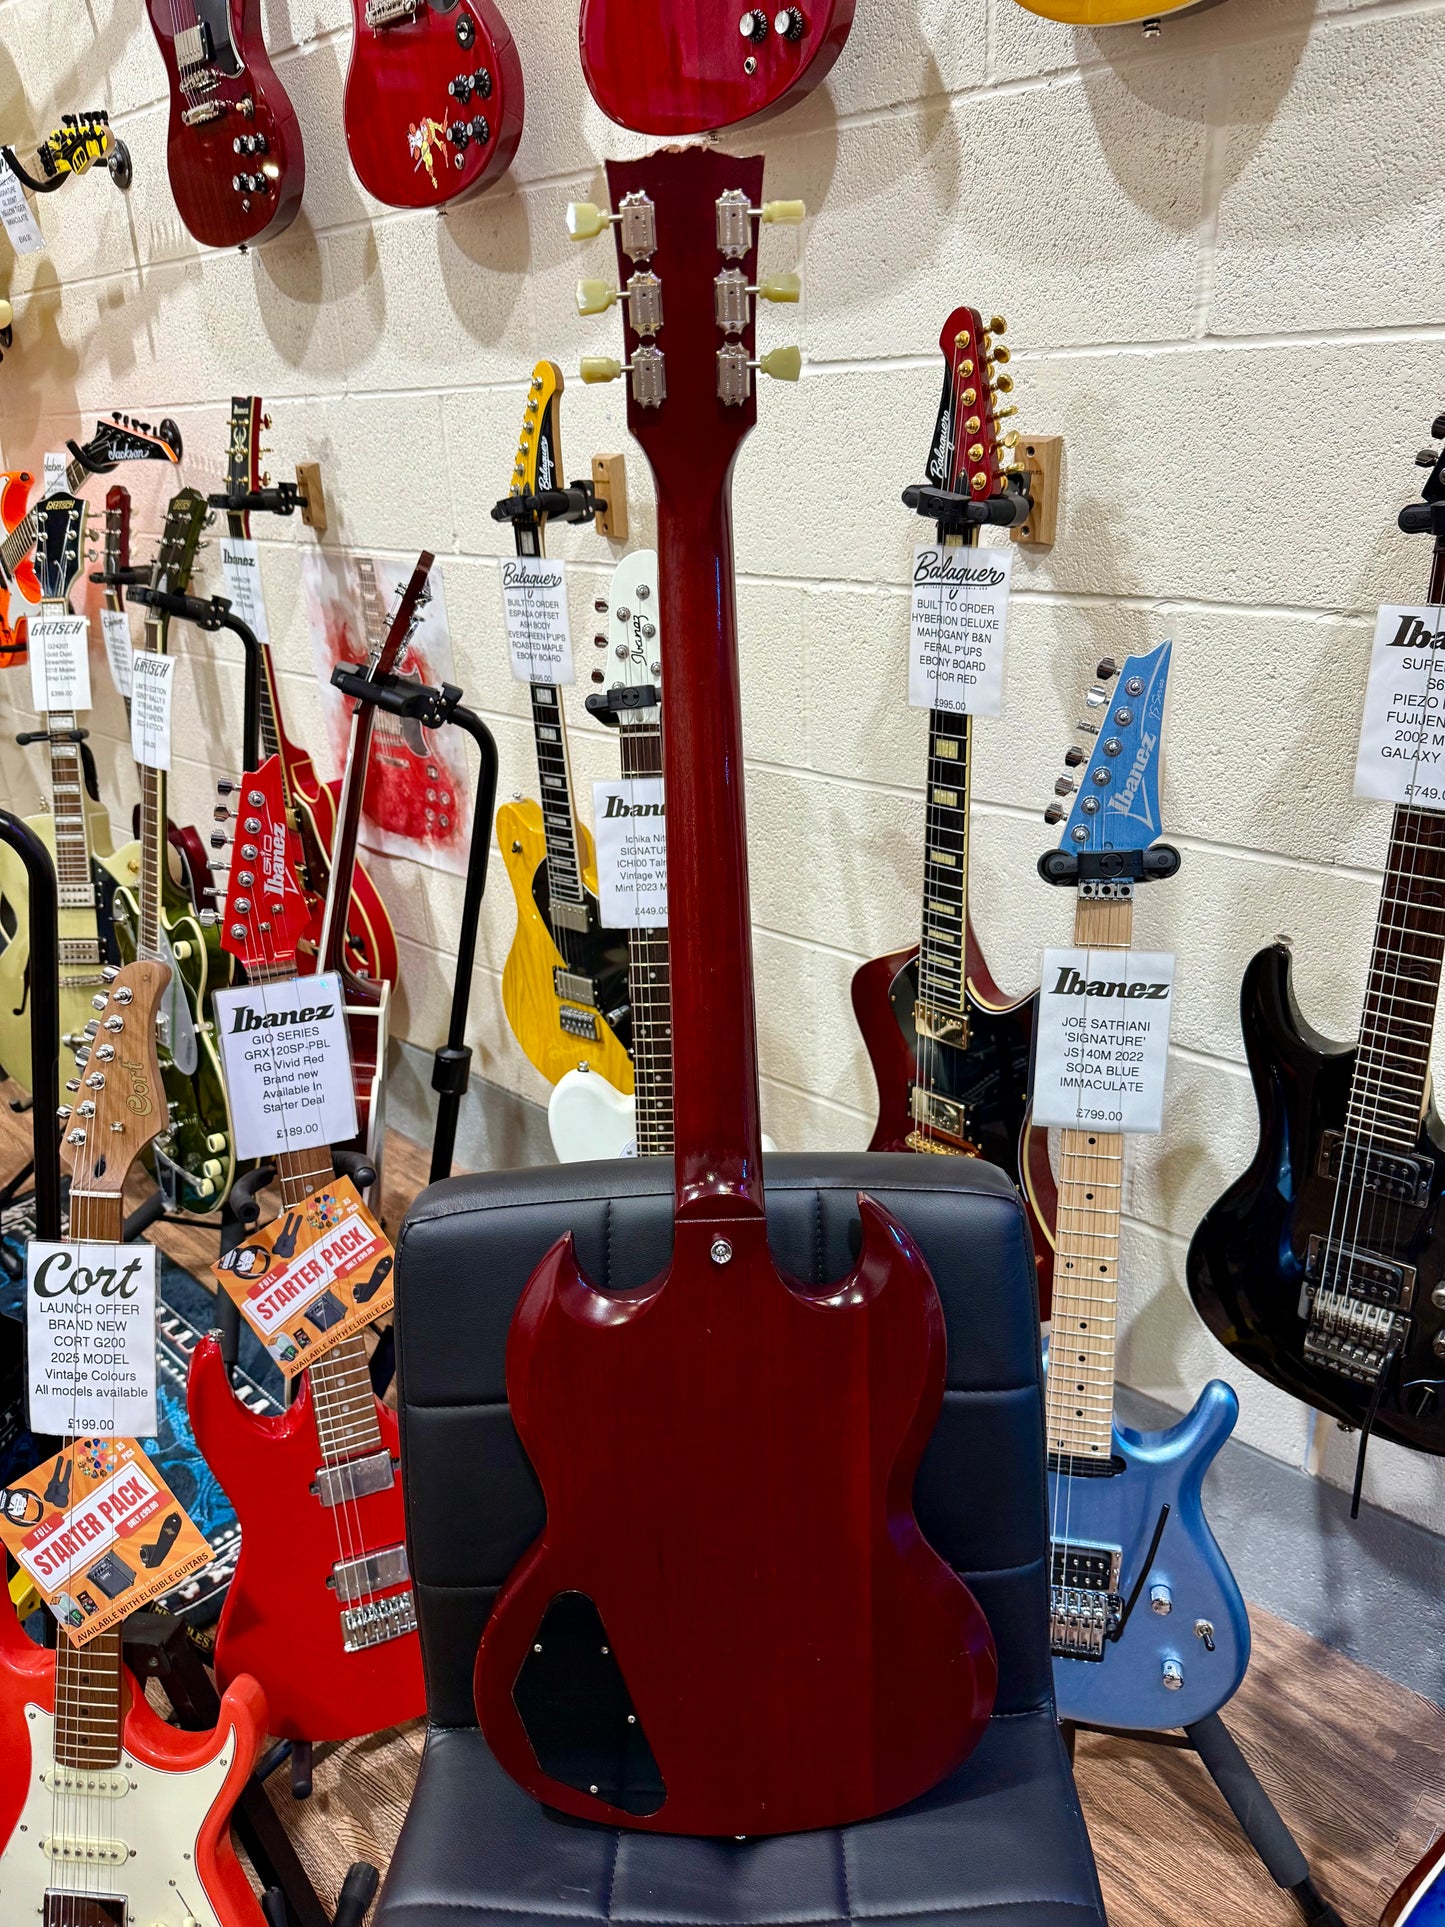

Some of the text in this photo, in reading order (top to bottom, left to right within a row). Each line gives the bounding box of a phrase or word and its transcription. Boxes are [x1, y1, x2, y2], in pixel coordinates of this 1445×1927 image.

[73, 149, 87, 171] LTD
[108, 441, 149, 460] Jackson
[929, 409, 955, 480] Balaguer
[538, 435, 554, 491] Balaguer
[46, 499, 75, 511] GRETSCH
[223, 549, 256, 567] Ibanez
[503, 562, 562, 599] Balaguer
[914, 551, 1005, 600] Balaguer
[507, 599, 559, 610] BUILT TO ORDER
[917, 599, 995, 615] BUILT TO ORDER
[534, 611, 560, 620] OFFSET
[912, 613, 999, 630] HYBERION DELUXE
[31, 621, 84, 637] GRETSCH
[533, 622, 551, 631] BODY
[1386, 615, 1445, 649] Iba
[631, 614, 648, 666] Ibanez
[917, 627, 992, 644] MAHOGANY B&N
[512, 641, 564, 653] ROASTED MAPLE
[924, 641, 952, 654] FERAL
[539, 653, 561, 663] BOARD
[919, 655, 986, 672] EBONY BOARD
[134, 657, 171, 678] GRETSCH
[926, 669, 977, 685] ICHOR RED
[1393, 692, 1438, 709] PIEZO
[1394, 730, 1429, 744] 2002
[1381, 746, 1441, 763] GALAXY
[1107, 731, 1156, 817] Ibanez
[601, 795, 667, 819] Iban
[625, 834, 651, 844] Ichika
[263, 822, 286, 899] Ibanez
[619, 870, 653, 882] Vintage
[615, 884, 634, 893] Mint
[636, 883, 658, 893] 2023
[1048, 967, 1170, 1000] Ibanez
[228, 1004, 335, 1035] Ibanez
[1062, 1017, 1150, 1032] JOE SATRIANI
[252, 1027, 320, 1046] GIO SERIES
[244, 1039, 331, 1061] GRX120SP-PBL
[1064, 1047, 1144, 1061] JS140M 2022
[254, 1053, 325, 1073] RG Vivid Red
[1066, 1063, 1139, 1077] SODA BLUE
[263, 1069, 319, 1086] Brand new
[1060, 1077, 1144, 1092] IMMACULATE
[121, 1060, 153, 1117] Cort
[263, 1082, 323, 1099] Available In
[263, 1095, 325, 1114] Starter Deal
[1075, 1107, 1123, 1121] £799.00
[276, 1123, 319, 1139] £189.00
[33, 1252, 143, 1299] Cort
[256, 1226, 368, 1321] STARTER PACK
[258, 1272, 278, 1291] FULL
[40, 1302, 139, 1315] LAUNCH OFFER
[49, 1319, 127, 1332] BRAND NEW
[54, 1336, 125, 1348] CORT G200
[289, 1344, 329, 1374] AVAILABLE
[327, 1328, 349, 1345] WITH
[348, 1307, 382, 1332] ELIGIBLE
[51, 1352, 129, 1365] 2025 MODEL
[45, 1368, 137, 1383] Vintage Colours
[35, 1384, 148, 1398] All models available
[68, 1417, 115, 1430] £199.00
[33, 1476, 150, 1577] STARTER PACK
[33, 1522, 53, 1541] FULL
[126, 1516, 142, 1530] ONLY
[77, 1611, 120, 1643] AVAILABLE
[118, 1597, 141, 1616] WITH
[139, 1575, 176, 1602] ELIGIBLE
[174, 1553, 209, 1578] GUITARS
